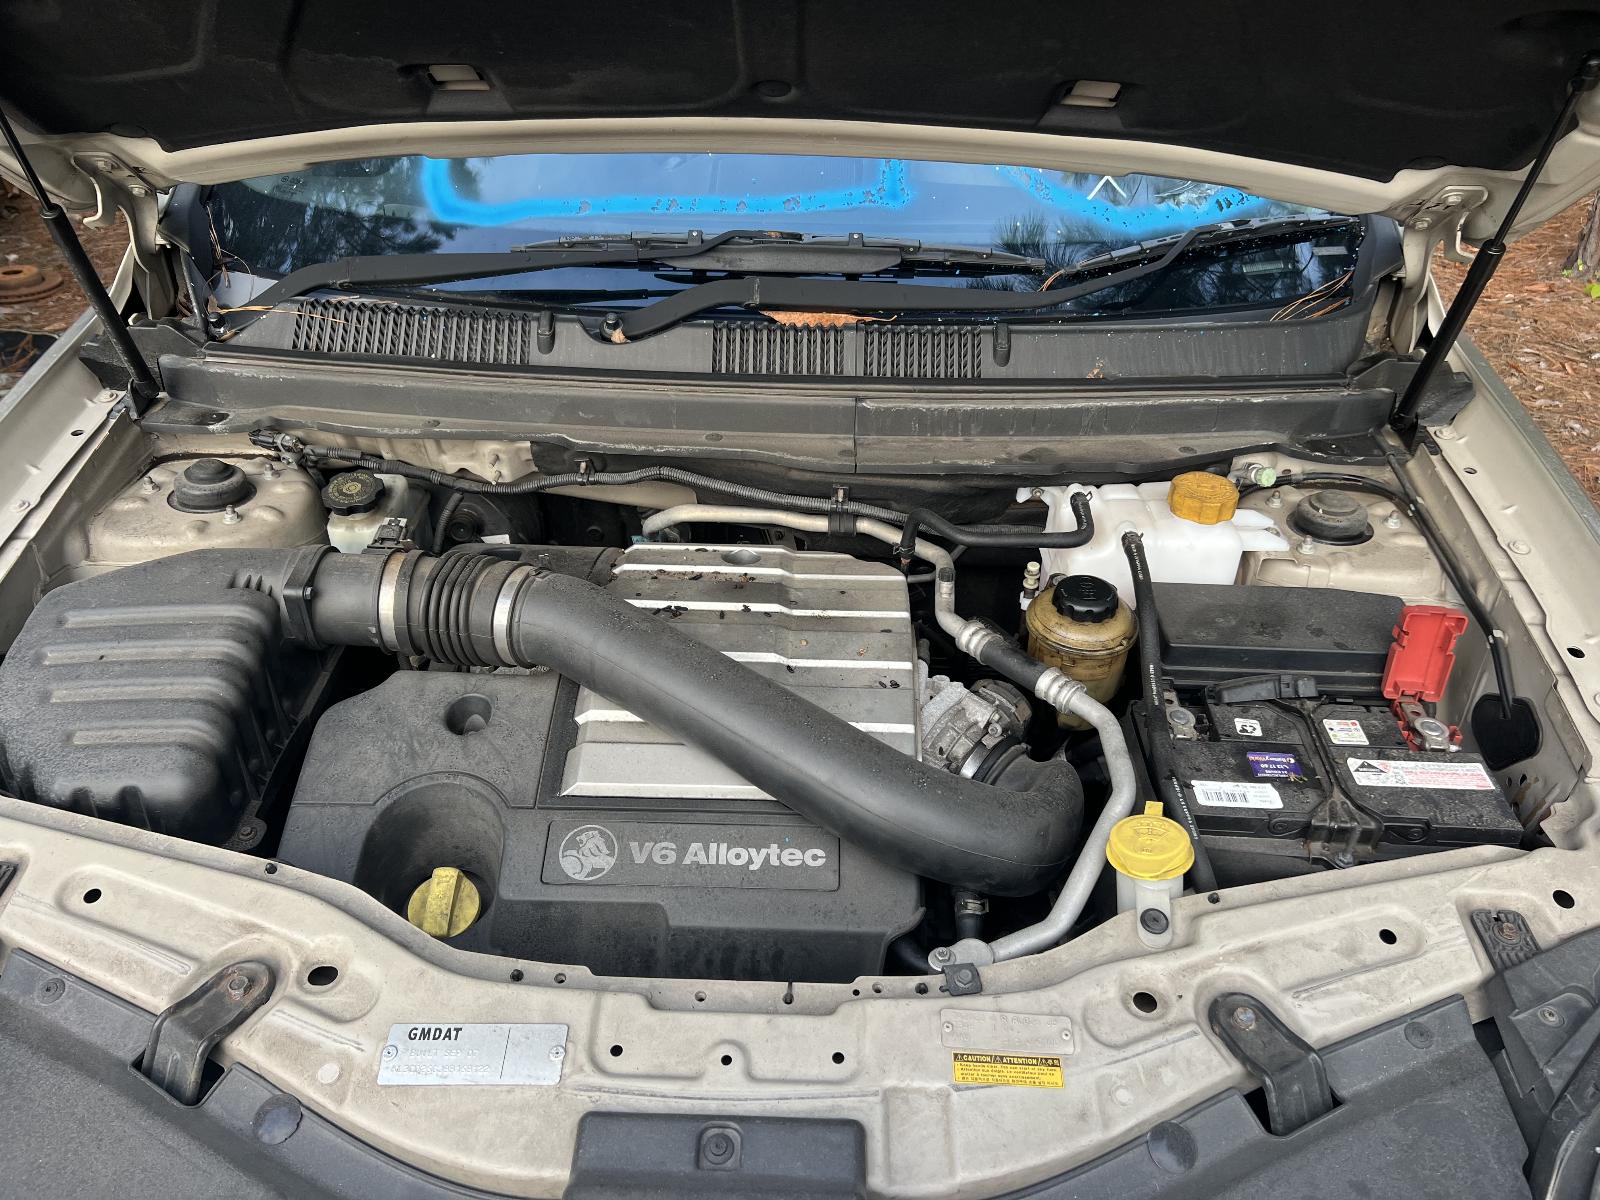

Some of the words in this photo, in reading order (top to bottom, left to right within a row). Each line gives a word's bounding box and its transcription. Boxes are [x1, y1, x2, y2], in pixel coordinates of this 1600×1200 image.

[629, 841, 676, 864] V6
[682, 842, 827, 871] Alloytec
[408, 1026, 463, 1041] GMDAT
[1003, 1057, 1037, 1065] ATTENTION
